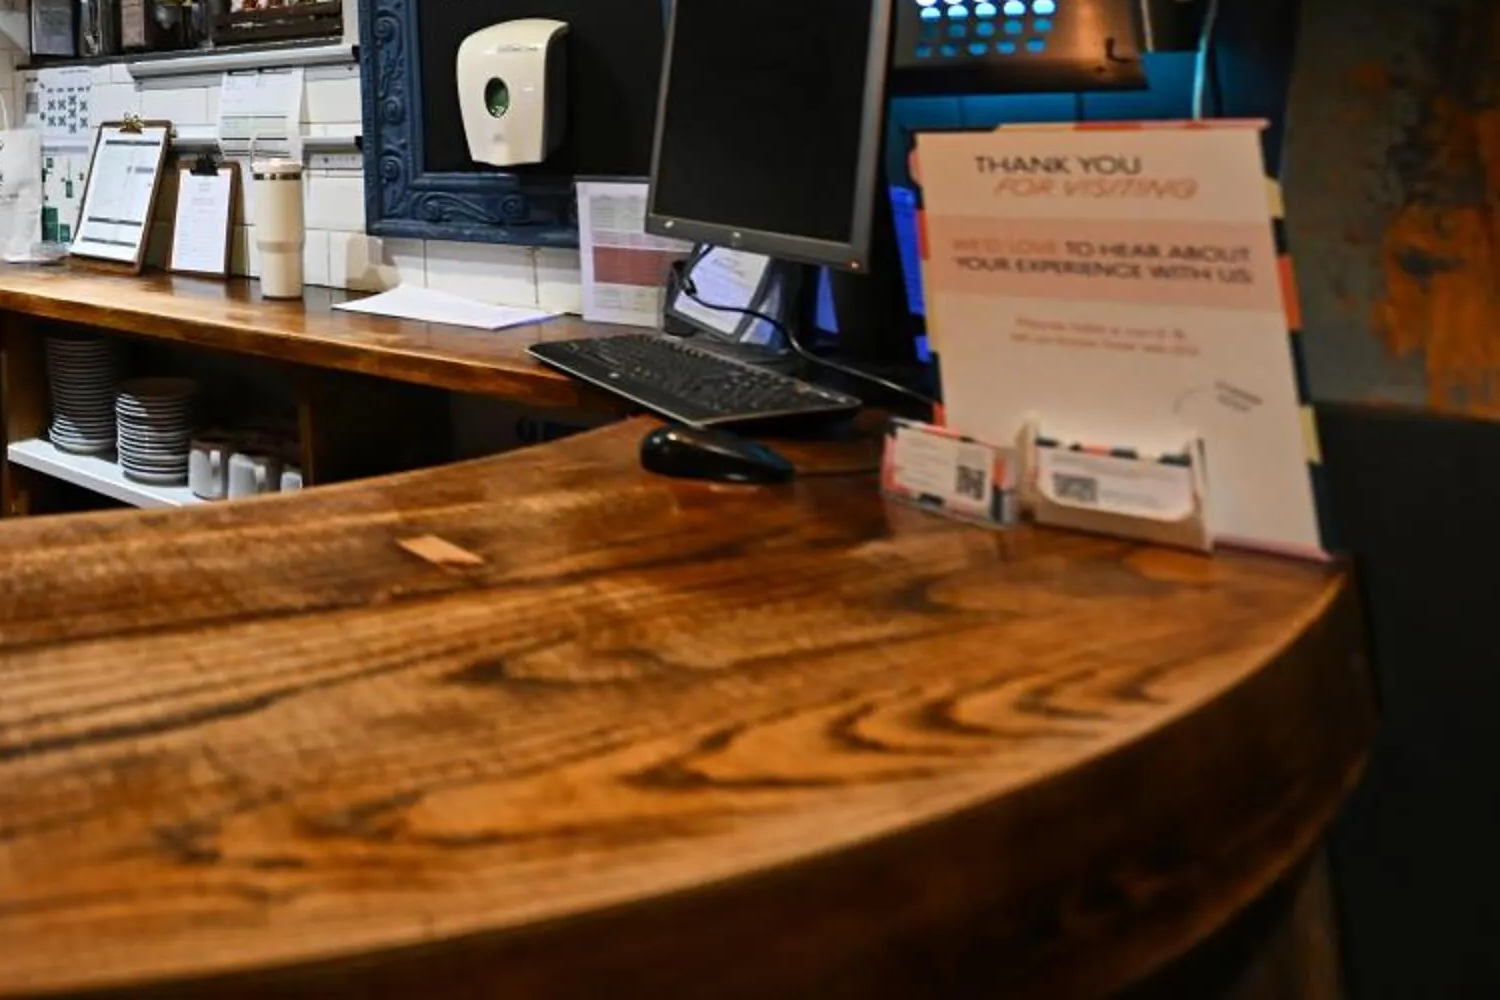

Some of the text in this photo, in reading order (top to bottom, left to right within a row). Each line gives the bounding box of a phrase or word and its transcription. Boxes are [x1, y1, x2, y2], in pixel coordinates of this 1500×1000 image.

[975, 154, 1143, 175] THANK YOU
[993, 177, 1199, 200] FOR VISITING
[1065, 241, 1096, 257] TO
[1099, 242, 1160, 258] HEAR
[1167, 244, 1251, 262] ABOUT
[954, 256, 1010, 273] YOUR
[1016, 258, 1142, 279] EXPERIENCE
[1148, 264, 1212, 281] WITH
